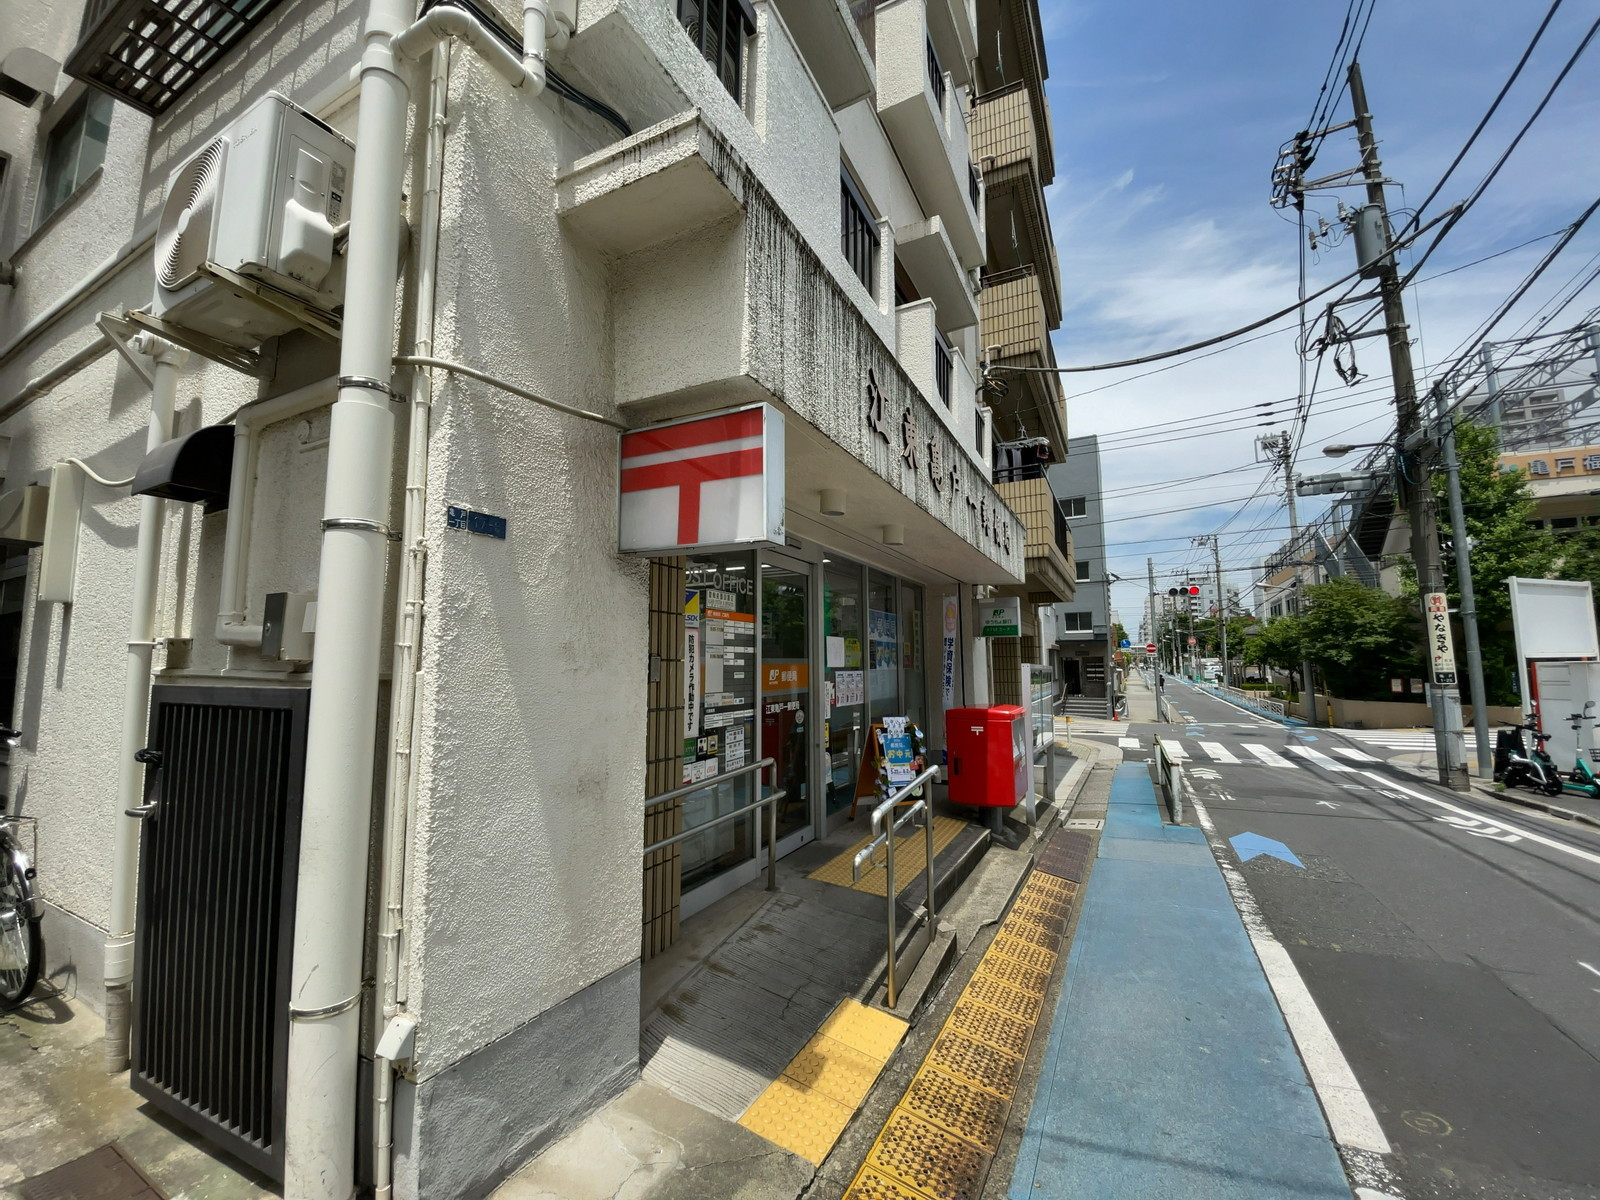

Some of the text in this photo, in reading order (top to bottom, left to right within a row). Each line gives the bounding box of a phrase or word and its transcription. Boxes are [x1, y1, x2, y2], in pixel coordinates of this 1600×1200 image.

[713, 572, 754, 596] OFFICE
[887, 749, 912, 758] お中元
